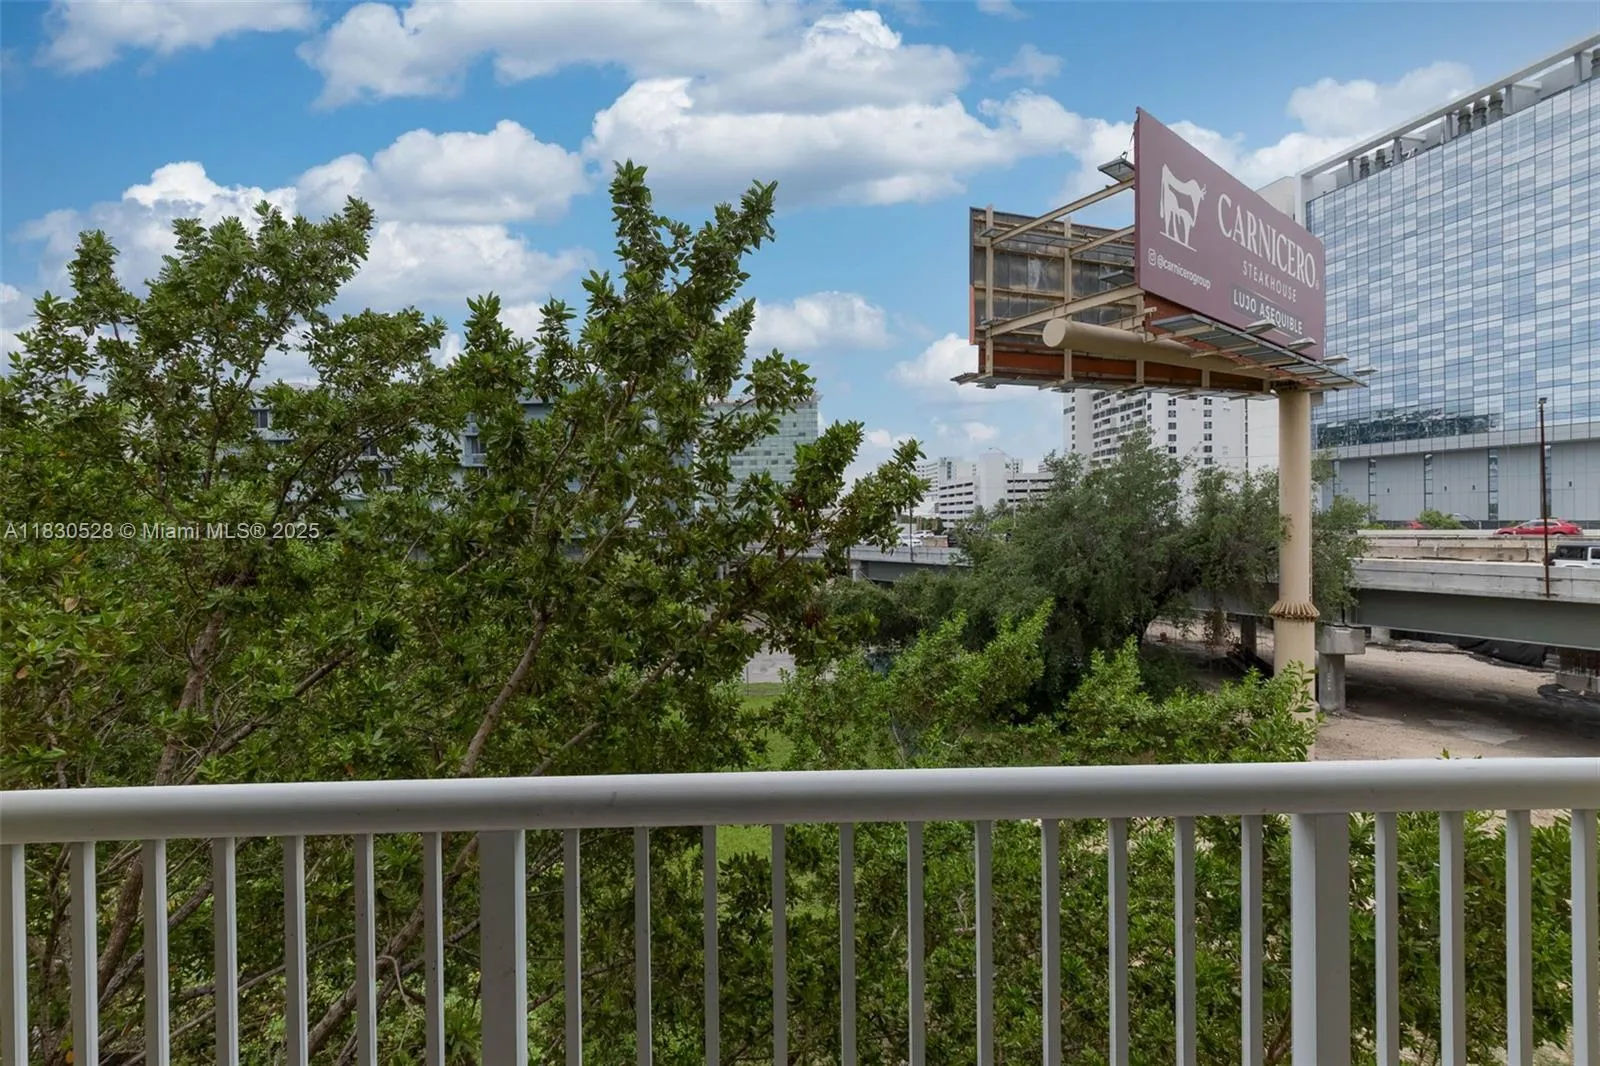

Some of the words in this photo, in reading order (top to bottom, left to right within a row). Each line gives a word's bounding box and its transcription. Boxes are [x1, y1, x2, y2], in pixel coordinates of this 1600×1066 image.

[1218, 193, 1316, 288] CARNICERO
[1157, 254, 1211, 290] @carnicerogroup
[1242, 260, 1297, 303] STEAKHOUSE
[1233, 289, 1257, 313] LUJO
[1259, 303, 1303, 335] ASEQUIBLE
